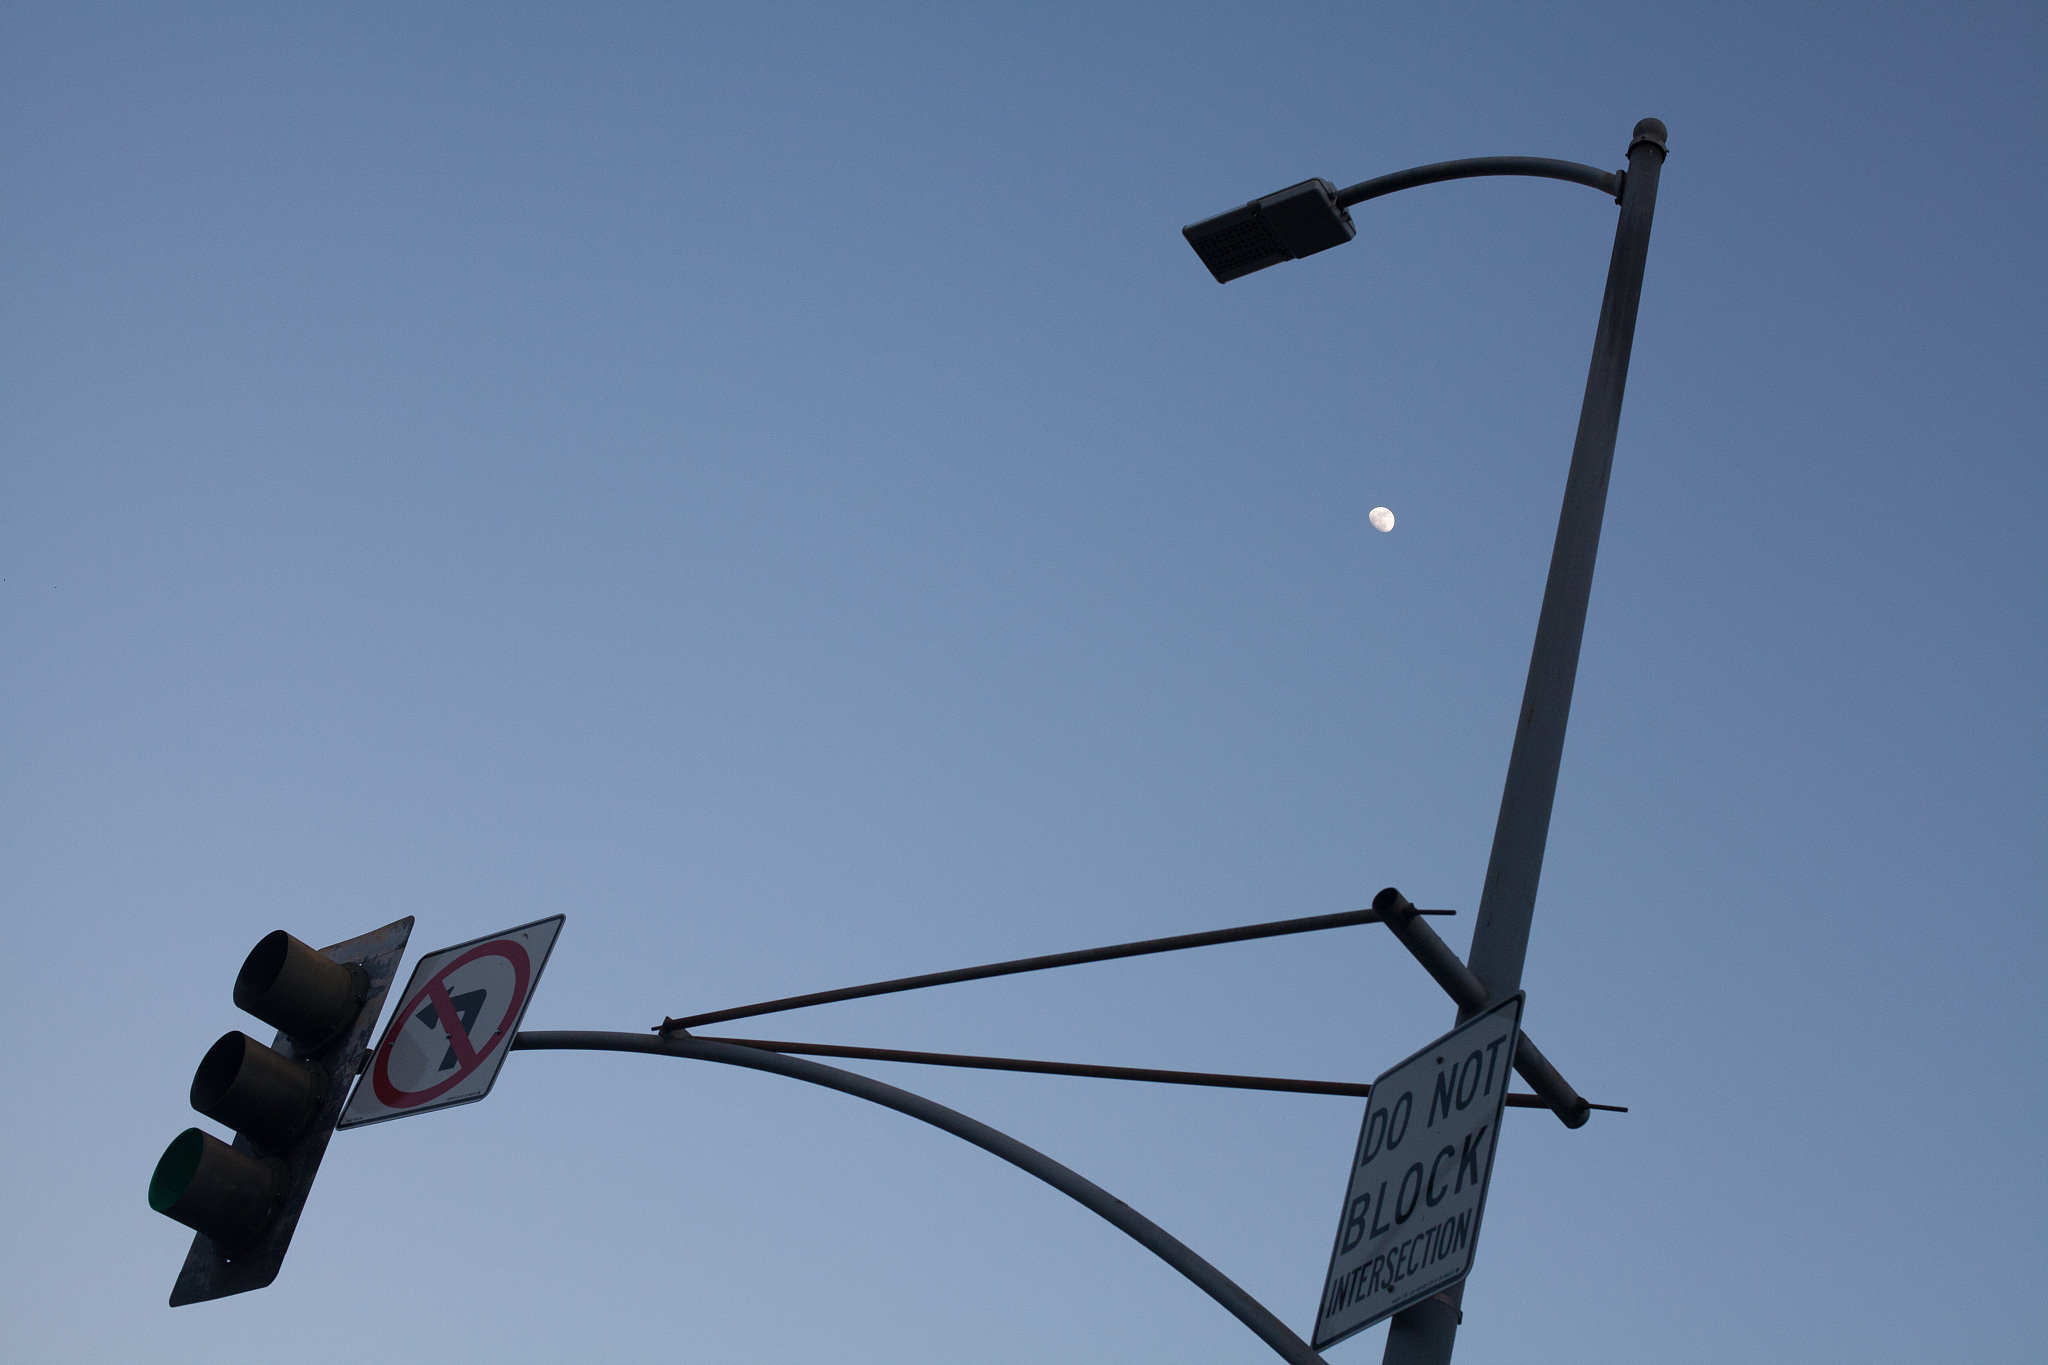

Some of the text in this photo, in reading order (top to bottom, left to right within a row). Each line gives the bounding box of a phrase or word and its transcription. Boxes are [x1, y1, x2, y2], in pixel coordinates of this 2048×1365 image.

[1361, 1034, 1507, 1167] DO NOT
[1340, 1125, 1488, 1255] BLOCK
[1325, 1207, 1473, 1318] INTERSECTION
